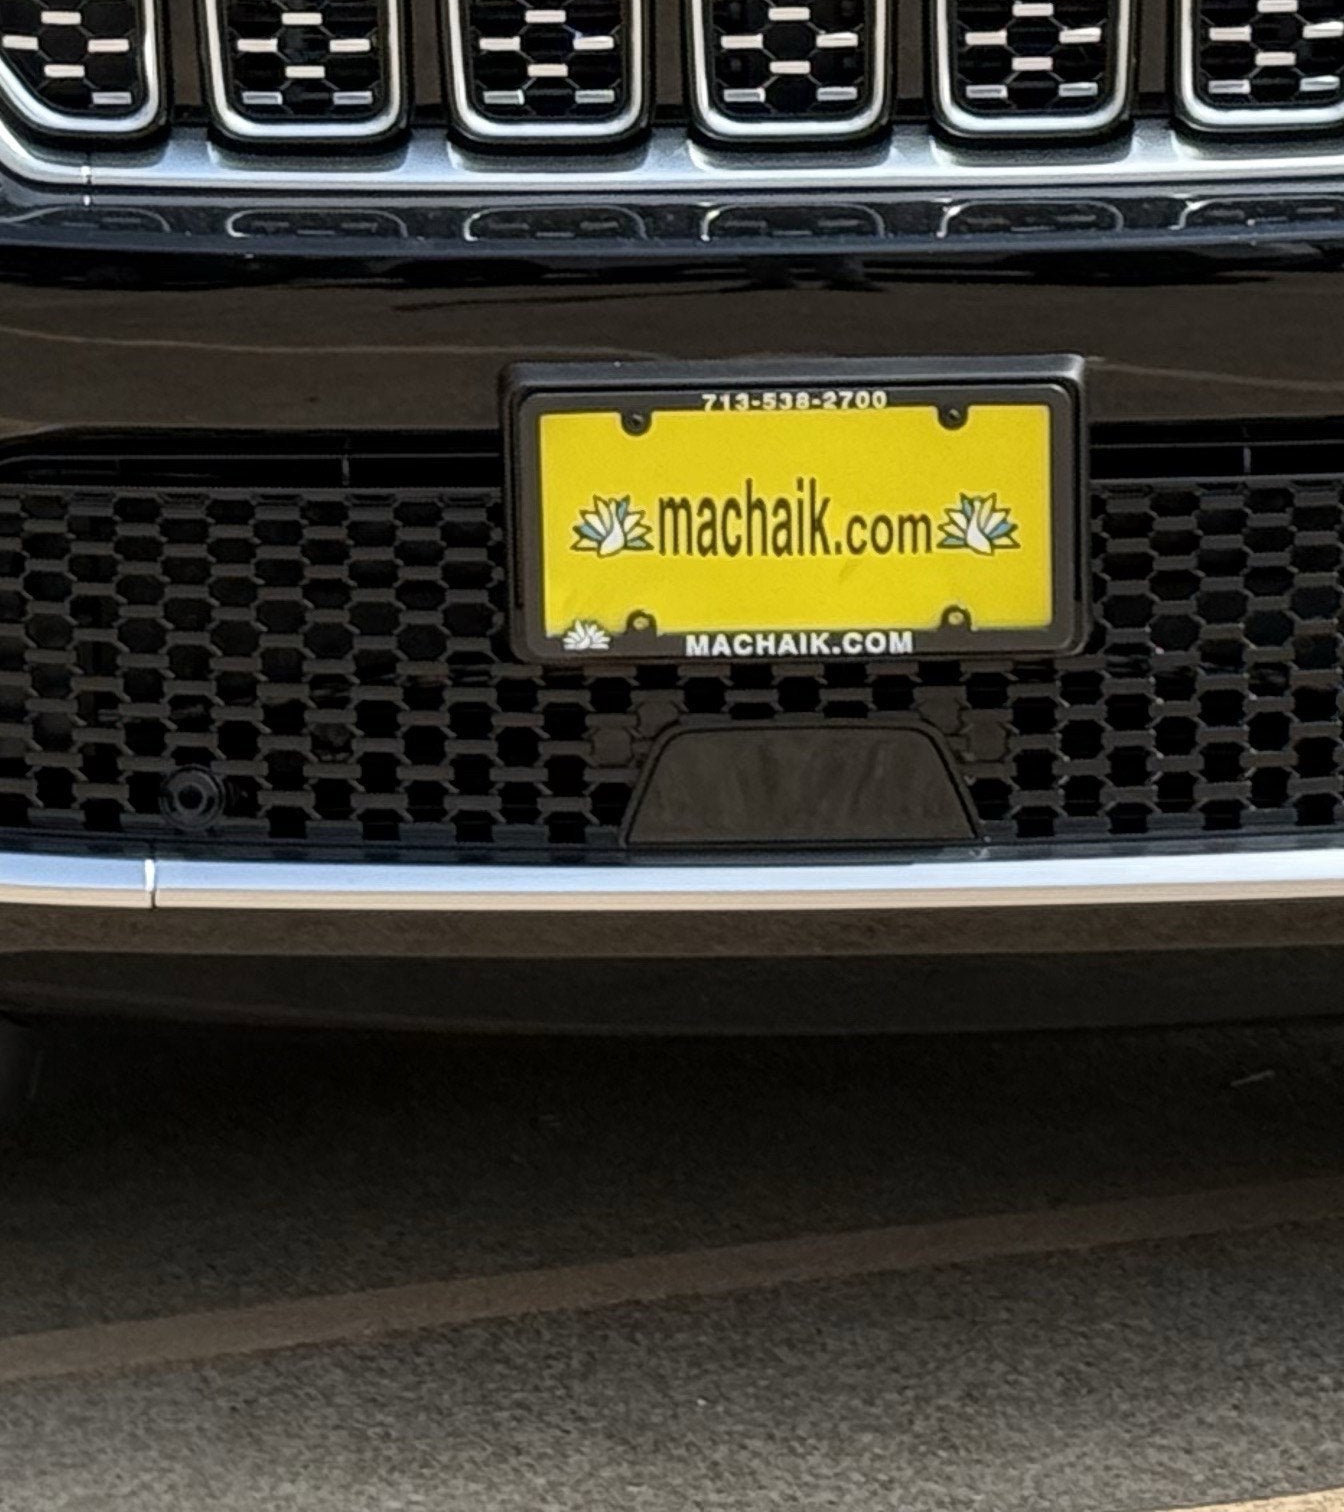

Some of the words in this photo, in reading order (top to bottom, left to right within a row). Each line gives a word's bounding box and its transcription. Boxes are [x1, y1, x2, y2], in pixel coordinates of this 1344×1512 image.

[702, 391, 887, 412] 713-538-2700
[658, 476, 932, 557] machaik.com
[685, 631, 914, 658] MACHAIK.COM
